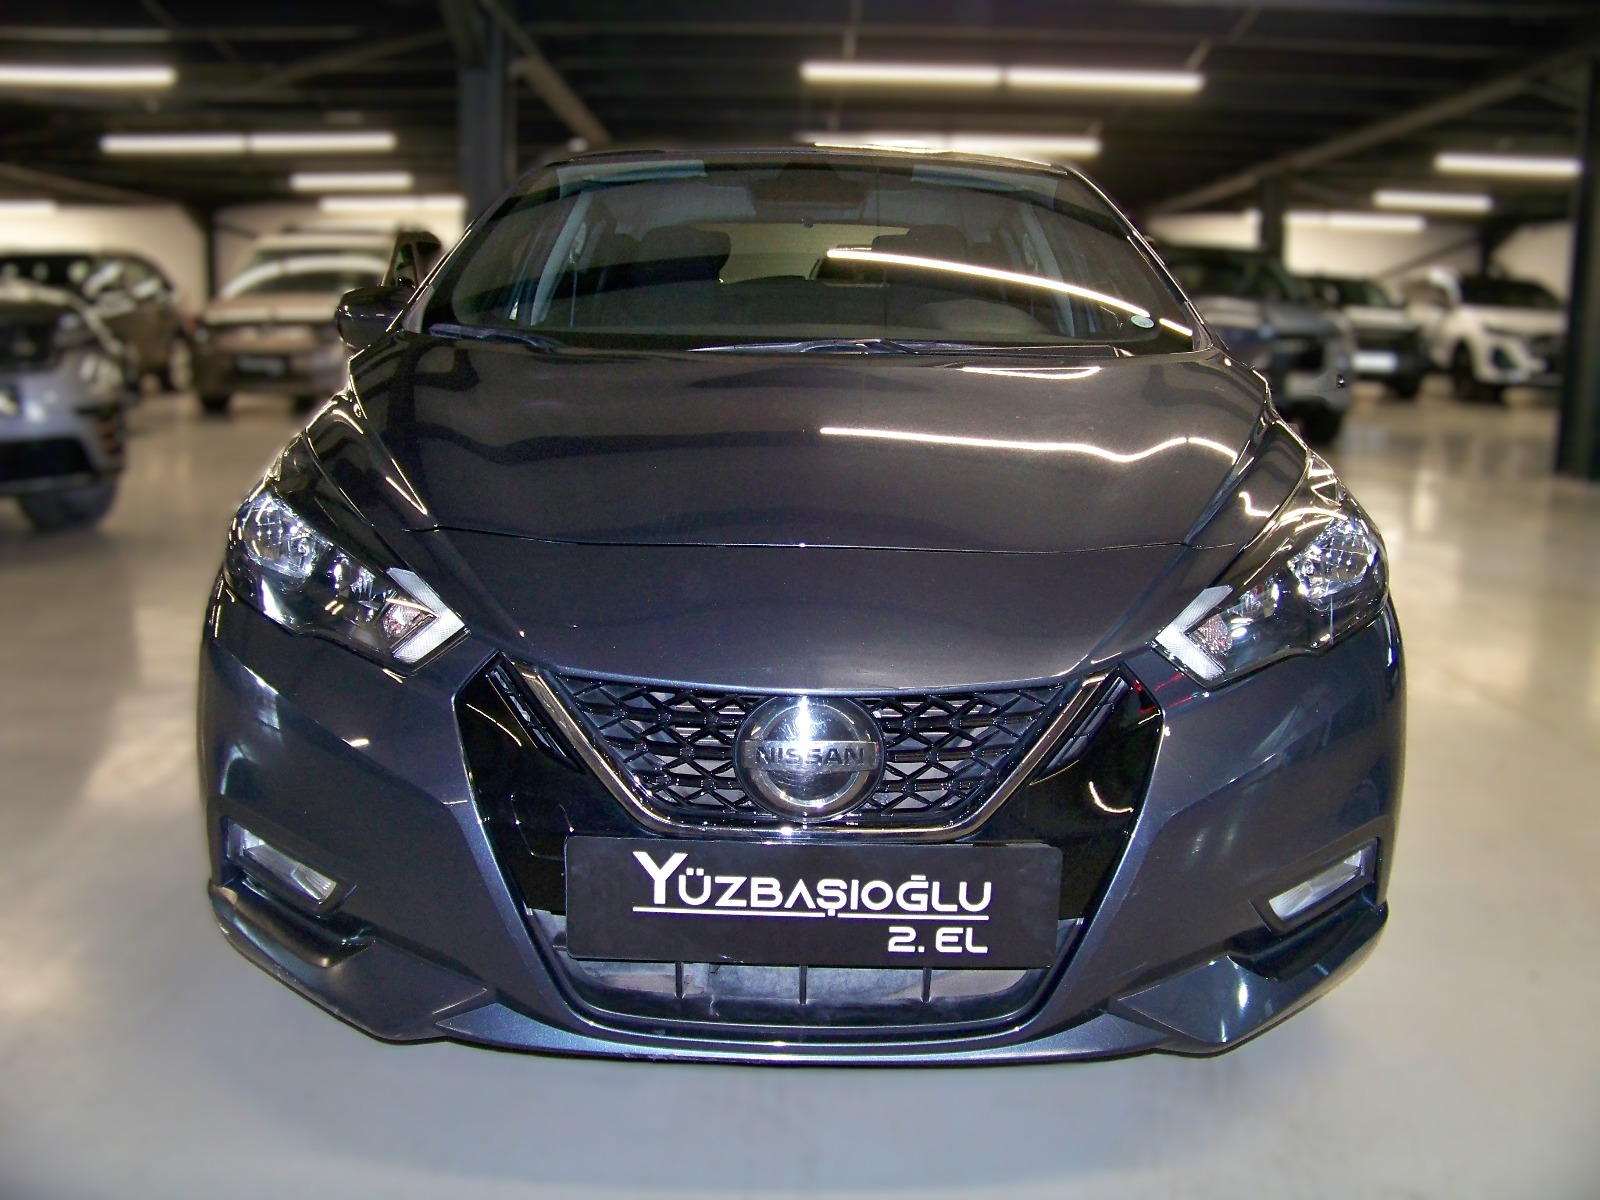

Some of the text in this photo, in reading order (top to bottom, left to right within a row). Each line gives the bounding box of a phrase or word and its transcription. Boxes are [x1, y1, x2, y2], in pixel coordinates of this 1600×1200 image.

[755, 746, 865, 765] NISSAN
[632, 850, 992, 916] YÜZBAŞIOĞLU
[887, 925, 989, 954] 2. EL
